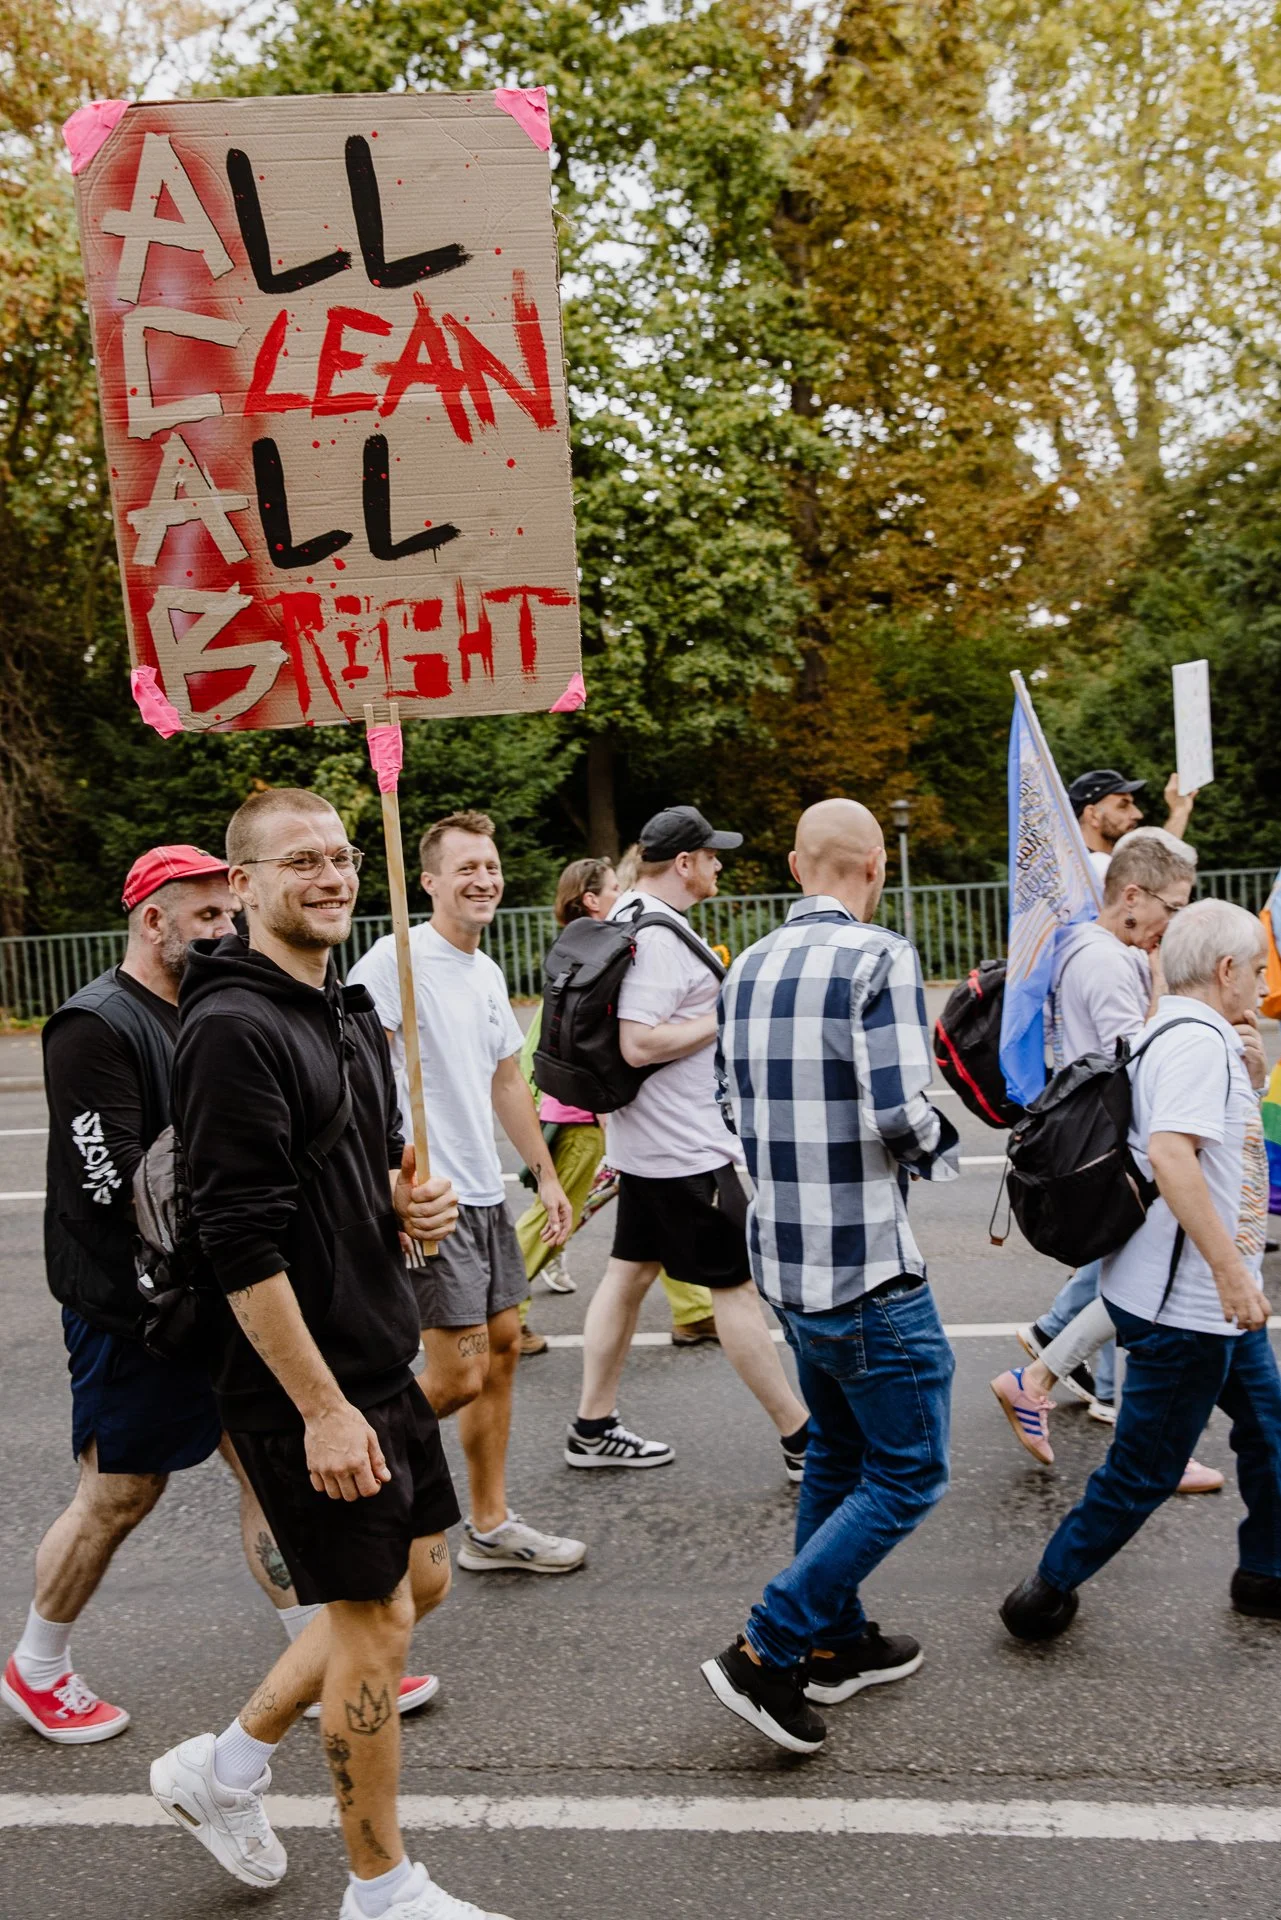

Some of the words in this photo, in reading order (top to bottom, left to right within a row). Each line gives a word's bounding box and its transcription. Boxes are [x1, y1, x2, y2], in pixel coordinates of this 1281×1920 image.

[101, 131, 474, 305] ALL
[122, 269, 558, 444] CLEAN
[126, 432, 462, 570] ALL
